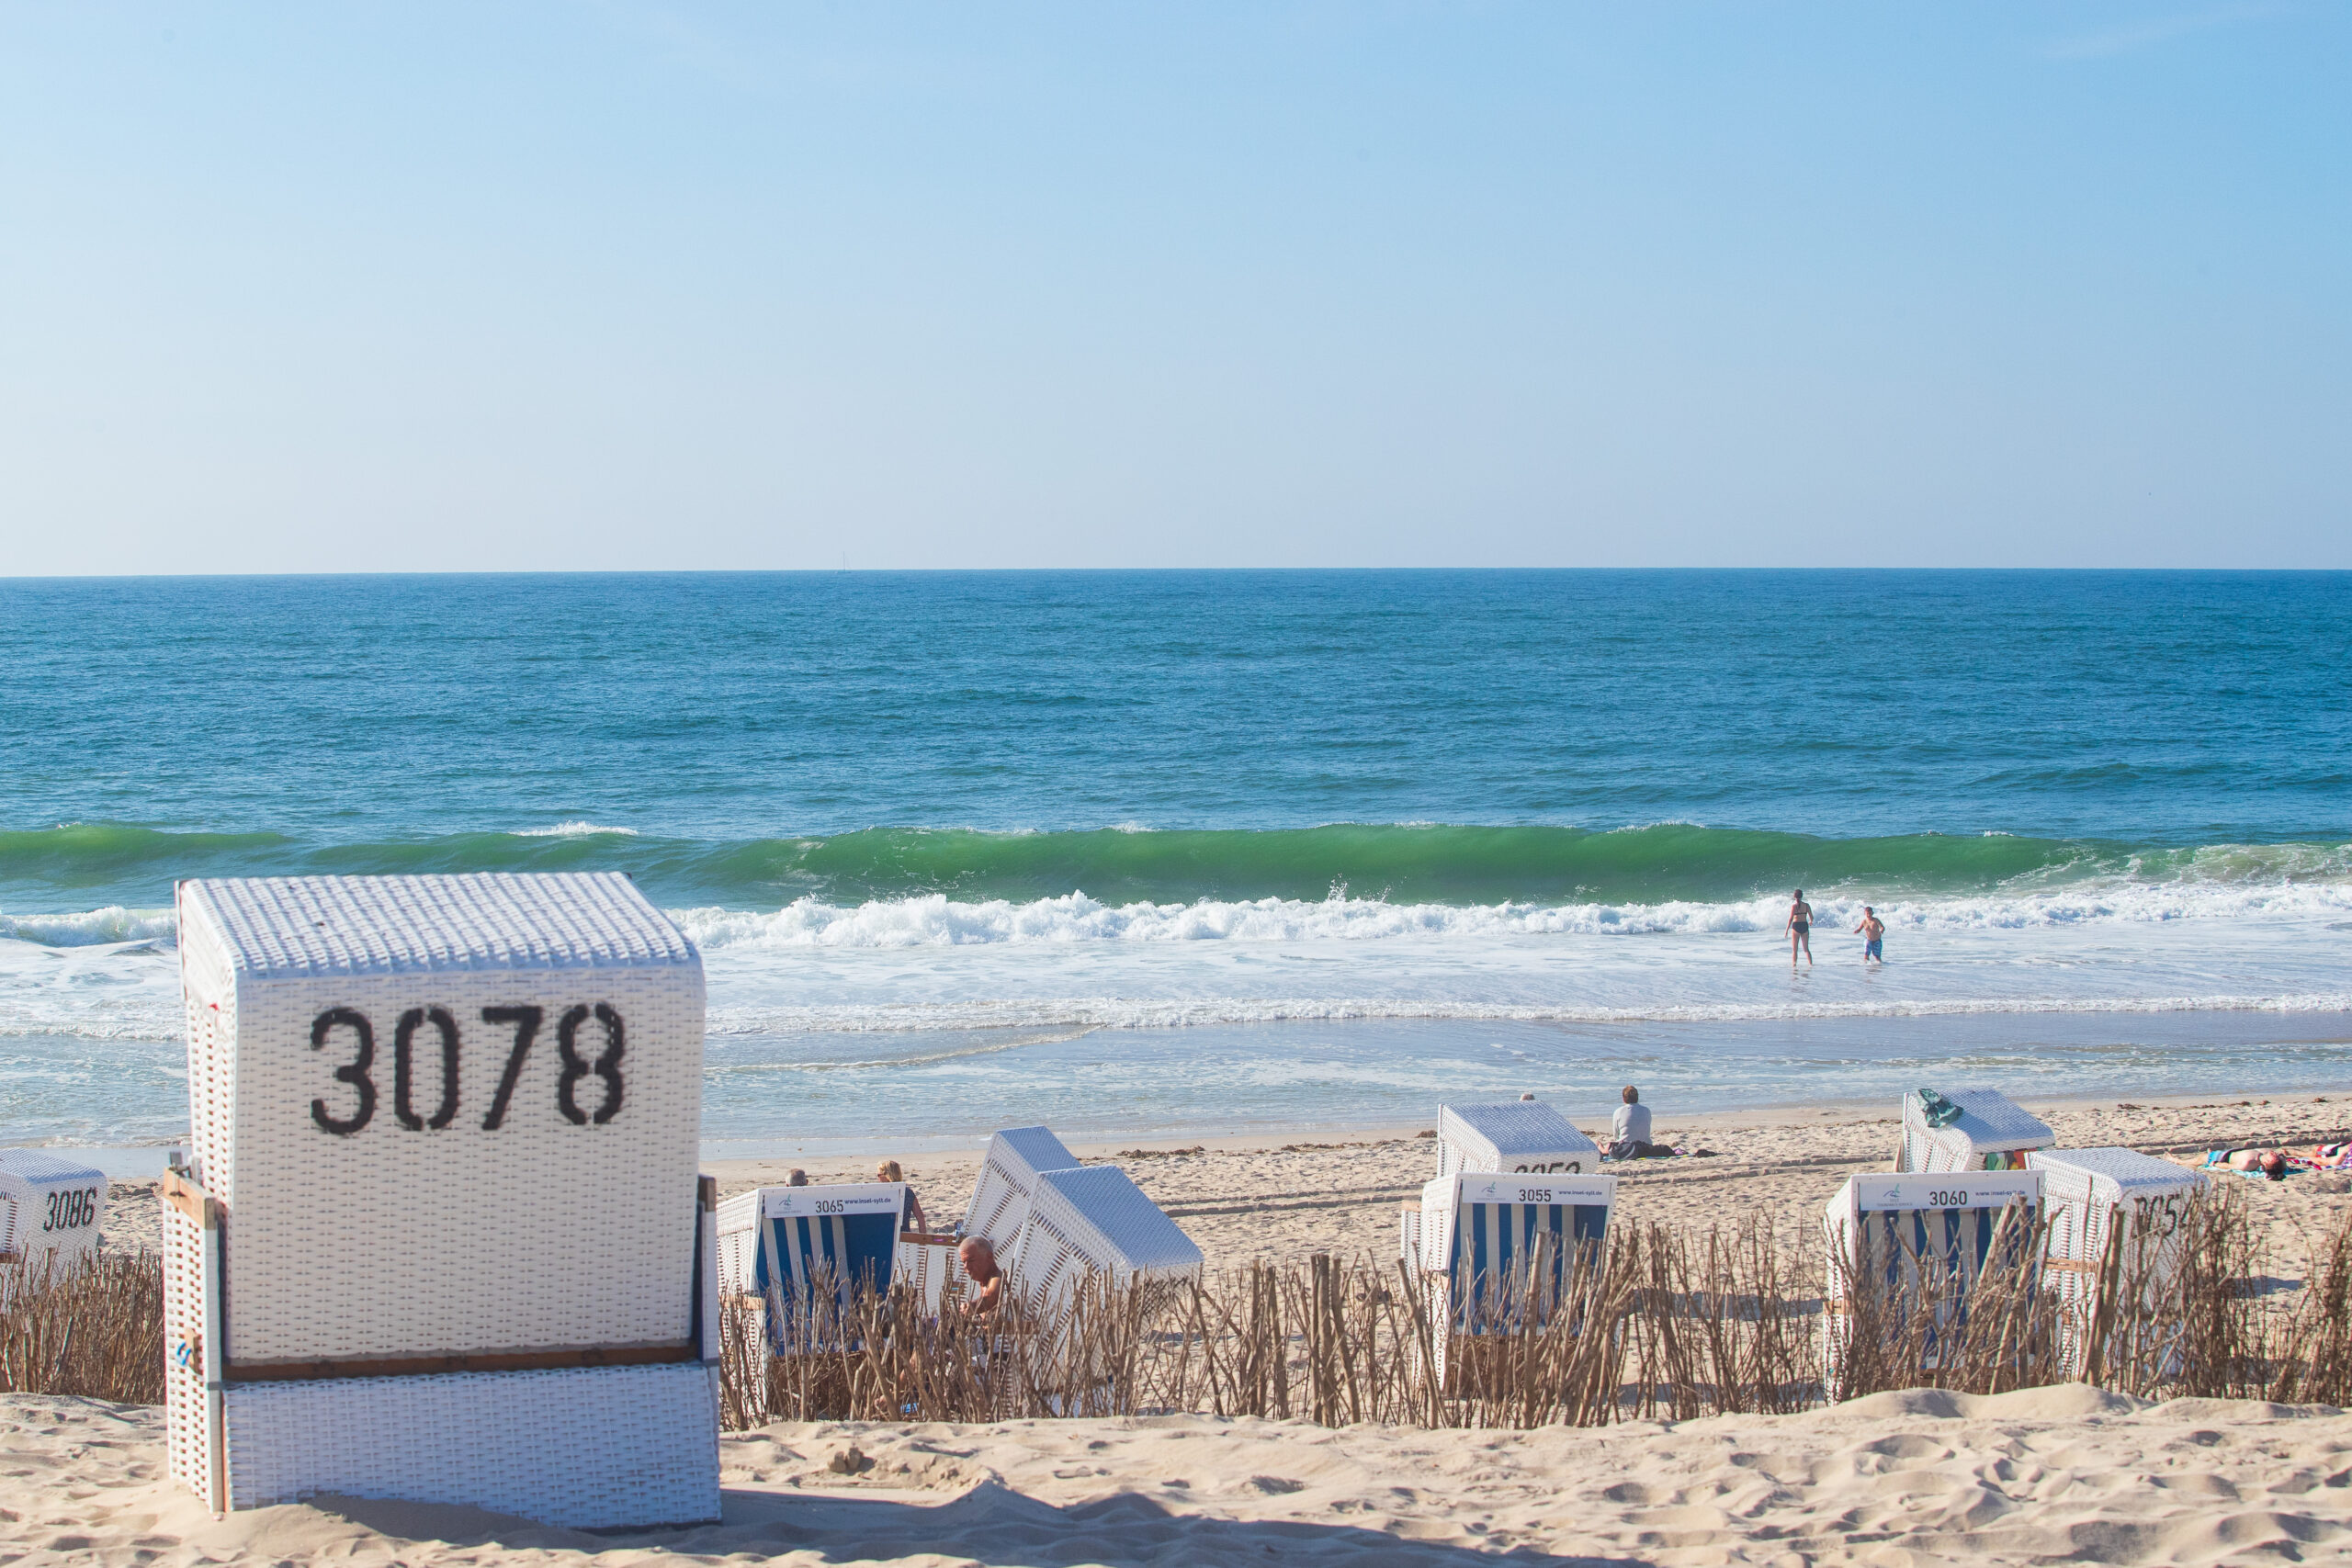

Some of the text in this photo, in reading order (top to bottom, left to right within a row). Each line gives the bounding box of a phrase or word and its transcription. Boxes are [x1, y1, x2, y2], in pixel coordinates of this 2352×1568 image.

[311, 1003, 625, 1135] 3078
[1519, 1190, 1552, 1202] 3055
[1929, 1190, 1968, 1205] 3060
[43, 1187, 98, 1232] 3086
[815, 1200, 844, 1213] 3065
[844, 1197, 891, 1205] www.insel-sylt.de
